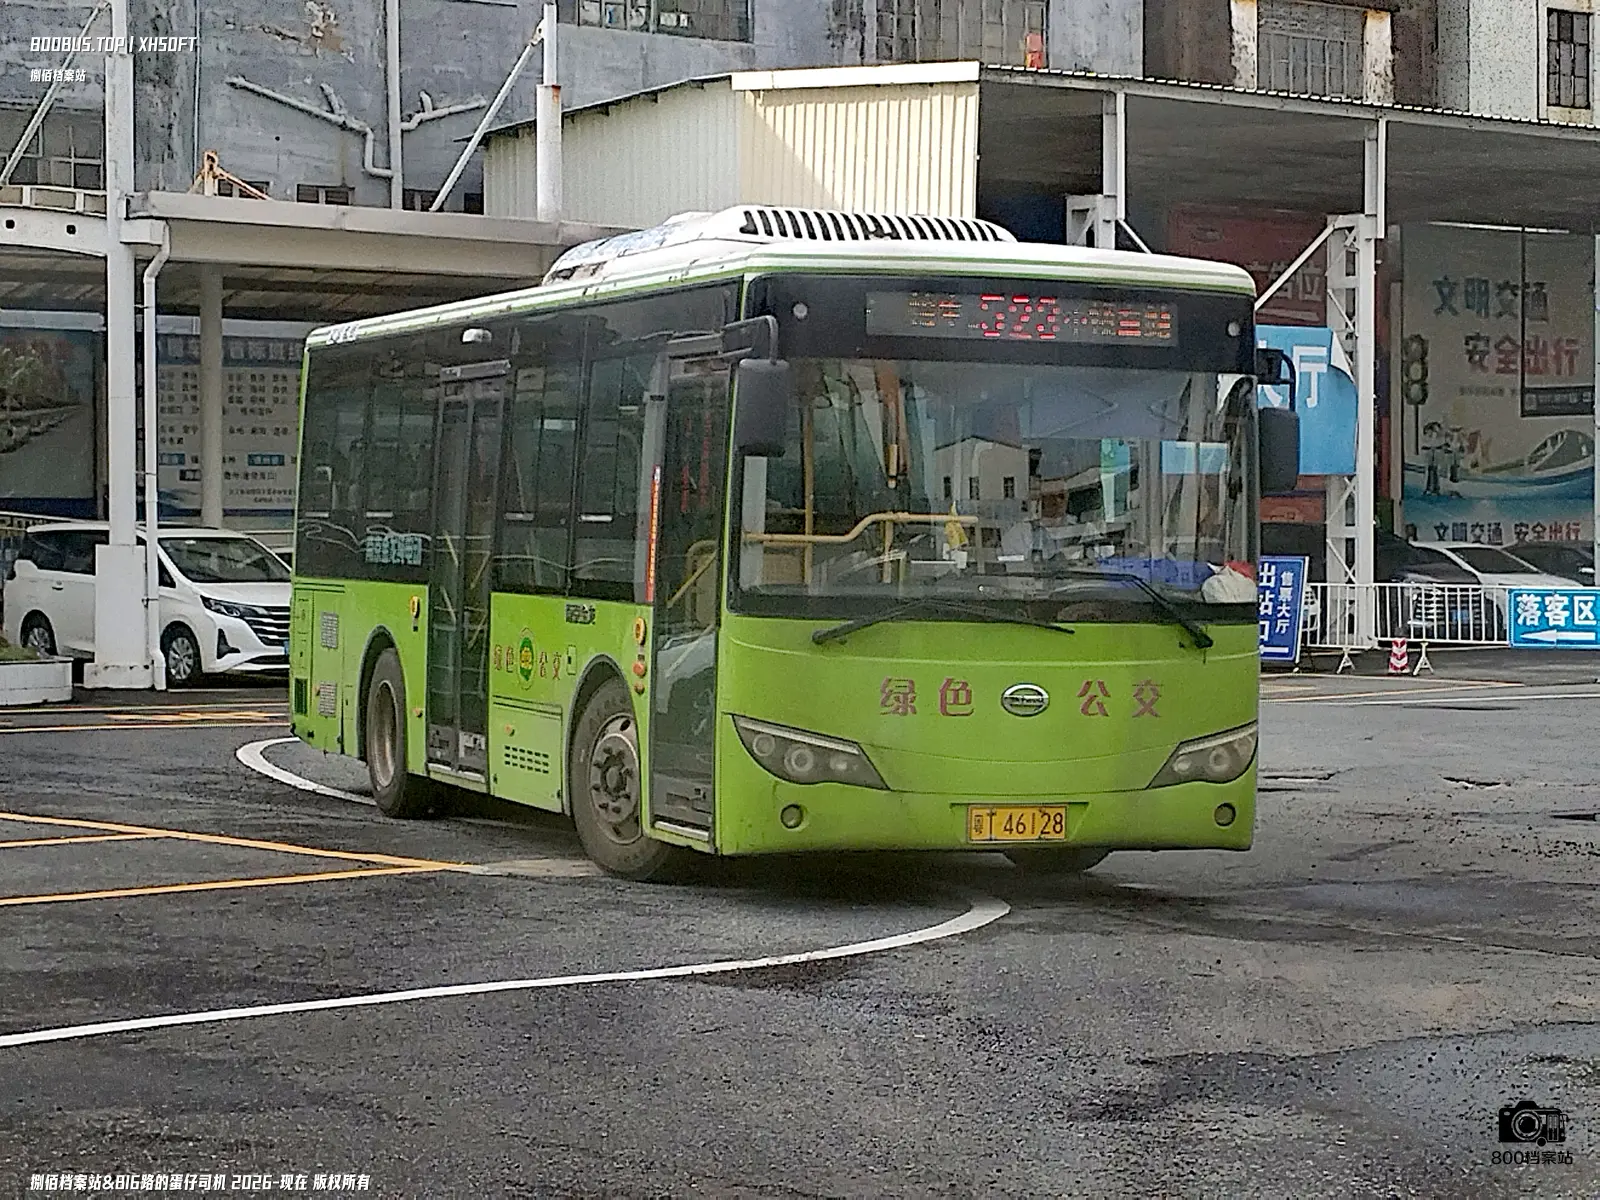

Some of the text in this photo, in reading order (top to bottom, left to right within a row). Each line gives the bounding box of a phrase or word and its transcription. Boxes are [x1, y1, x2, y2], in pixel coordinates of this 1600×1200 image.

[1432, 274, 1548, 321] 文明交通
[1464, 331, 1580, 376] 安全出行
[1514, 521, 1581, 542] 安全出行
[1516, 593, 1597, 627] 落客区
[879, 676, 1165, 718] 绿色 公交
